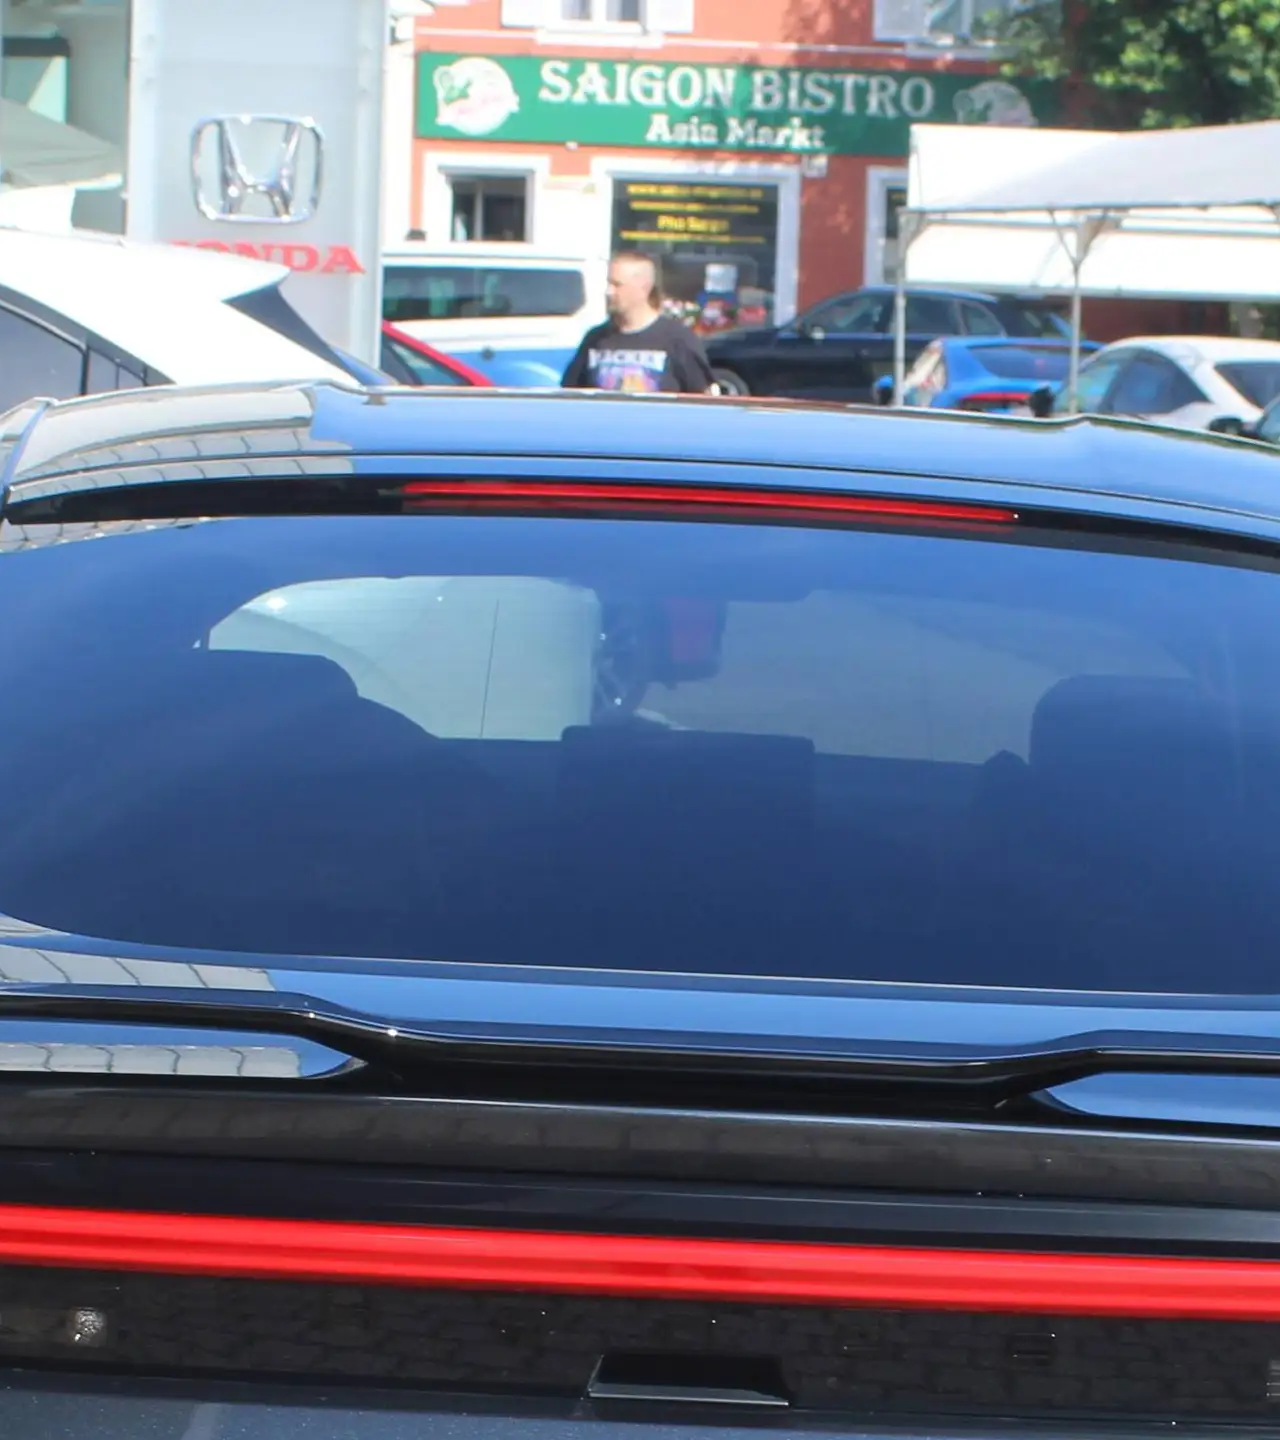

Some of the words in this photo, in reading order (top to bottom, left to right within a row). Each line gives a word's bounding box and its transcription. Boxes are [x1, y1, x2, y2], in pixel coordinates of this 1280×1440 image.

[537, 59, 737, 108] SAIGON
[751, 69, 935, 119] BISTRO
[644, 113, 718, 143] Asia
[725, 116, 827, 149] Markt
[170, 239, 367, 274] NDA
